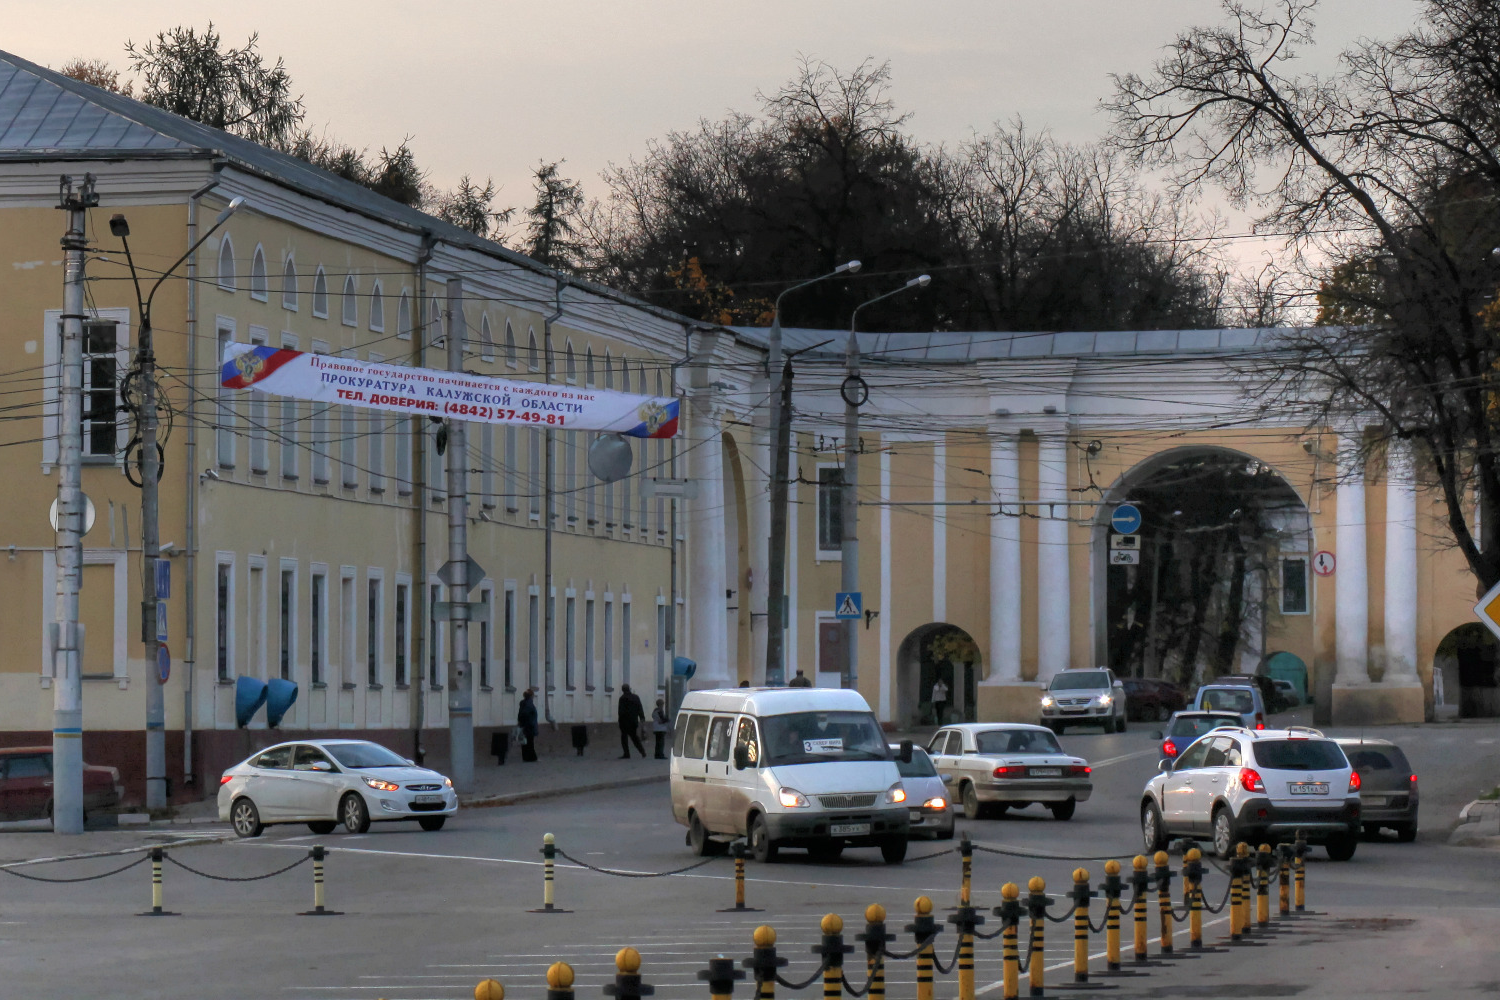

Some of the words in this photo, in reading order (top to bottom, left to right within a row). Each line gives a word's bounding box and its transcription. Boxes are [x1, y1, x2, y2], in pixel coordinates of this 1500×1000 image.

[310, 356, 364, 374] Правовое
[367, 367, 435, 383] государство
[438, 377, 500, 391] начинается
[512, 386, 558, 398] каждого
[561, 392, 574, 400] из
[577, 393, 595, 402] нас
[320, 372, 416, 395] ПРОКУРАТУРА
[426, 386, 511, 406] КАЛУЖСКОЙ
[521, 398, 583, 414] ОБЛАСТИ
[336, 388, 367, 402] ТЕЛ.
[369, 393, 439, 411] ДОВЕРИЯ:
[444, 401, 493, 420] (4842)
[496, 408, 565, 426] 57-49-81
[804, 741, 812, 752] 3
